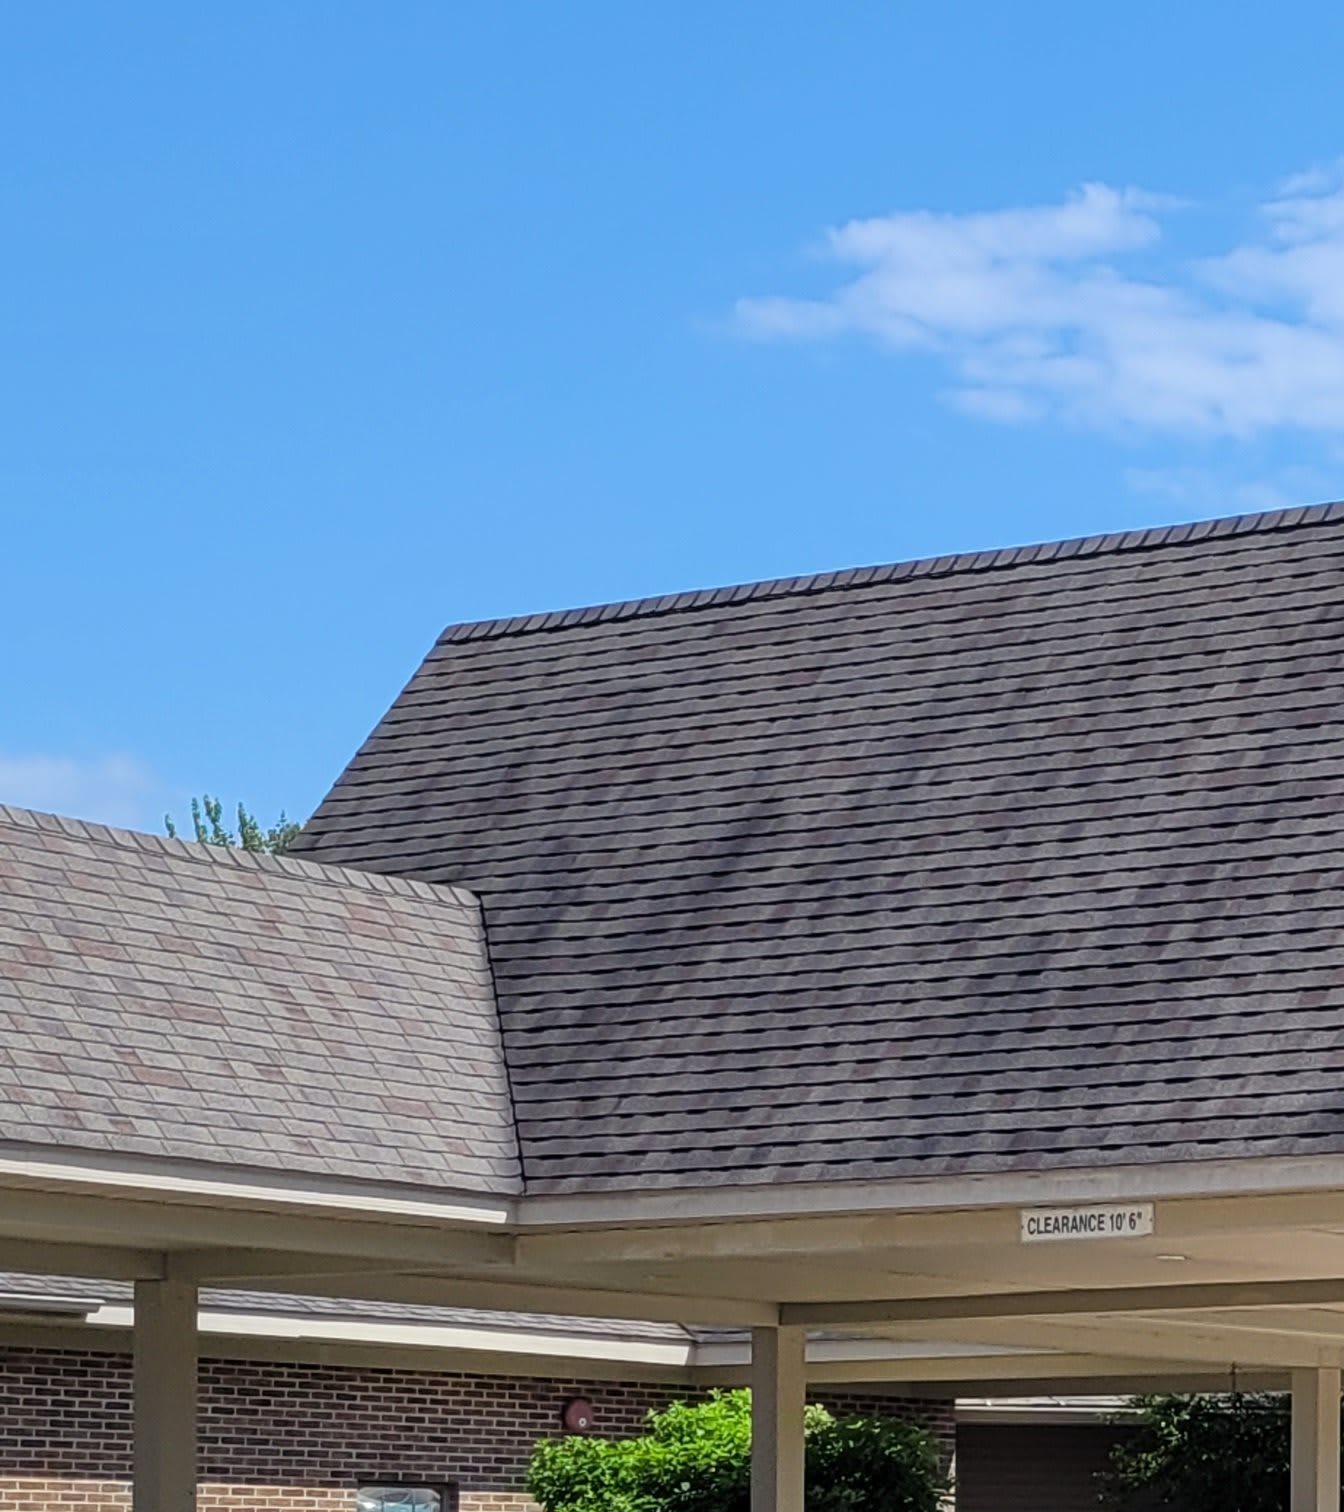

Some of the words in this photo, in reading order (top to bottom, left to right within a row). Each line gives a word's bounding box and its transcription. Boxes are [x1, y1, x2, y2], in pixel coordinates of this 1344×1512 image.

[1027, 1214, 1106, 1235] CLEARANCE
[1109, 1213, 1127, 1232] 10'
[1128, 1211, 1143, 1231] 6"
